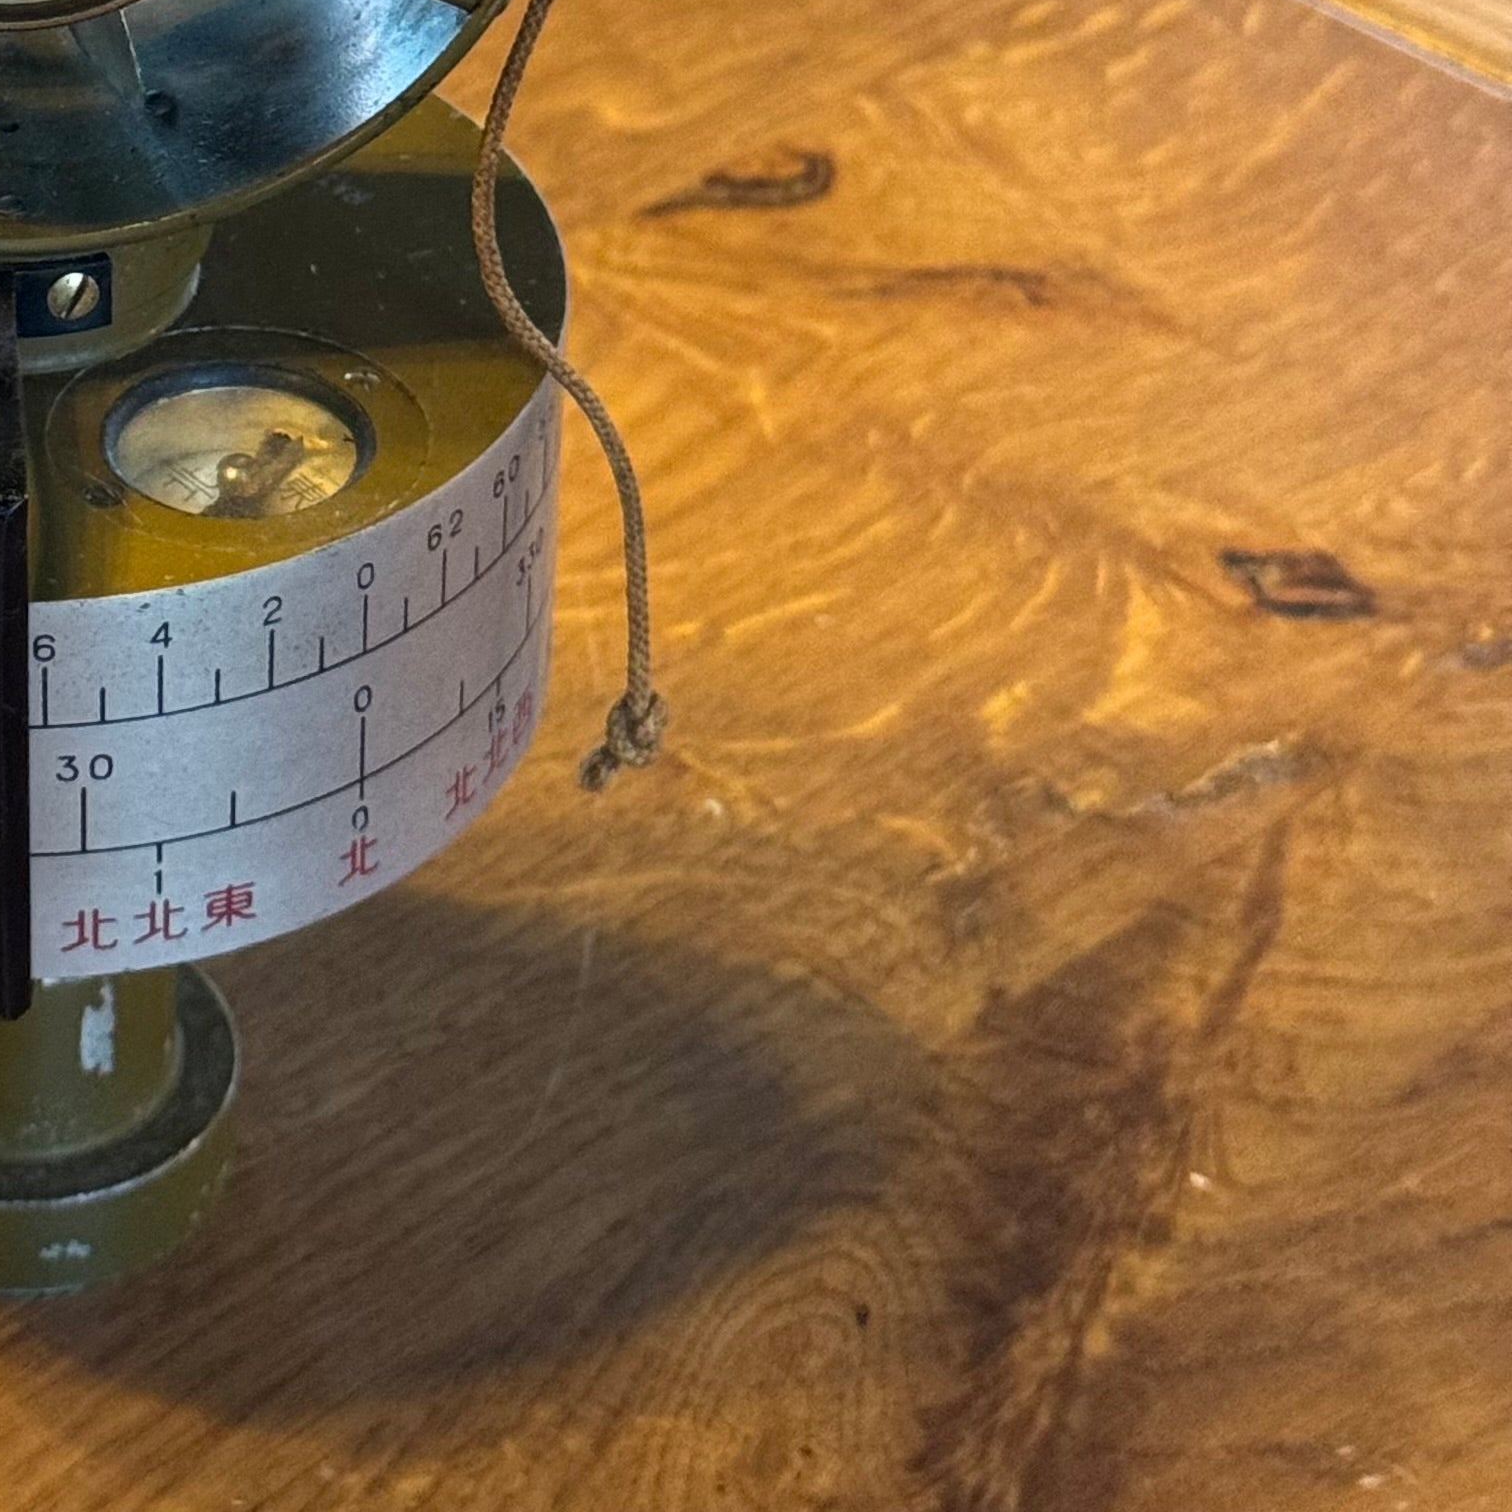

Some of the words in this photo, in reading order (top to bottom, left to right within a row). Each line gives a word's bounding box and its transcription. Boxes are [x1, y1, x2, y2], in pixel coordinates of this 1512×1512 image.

[493, 455, 520, 498] 60
[427, 509, 464, 552] 62
[357, 563, 376, 590] 0
[262, 597, 283, 626] 2
[33, 634, 56, 662] 6
[150, 623, 172, 647] 4
[354, 685, 373, 714] 0
[55, 754, 114, 782] 30
[351, 806, 370, 832] 0
[339, 835, 378, 886] 北
[61, 882, 257, 952] 北北東
